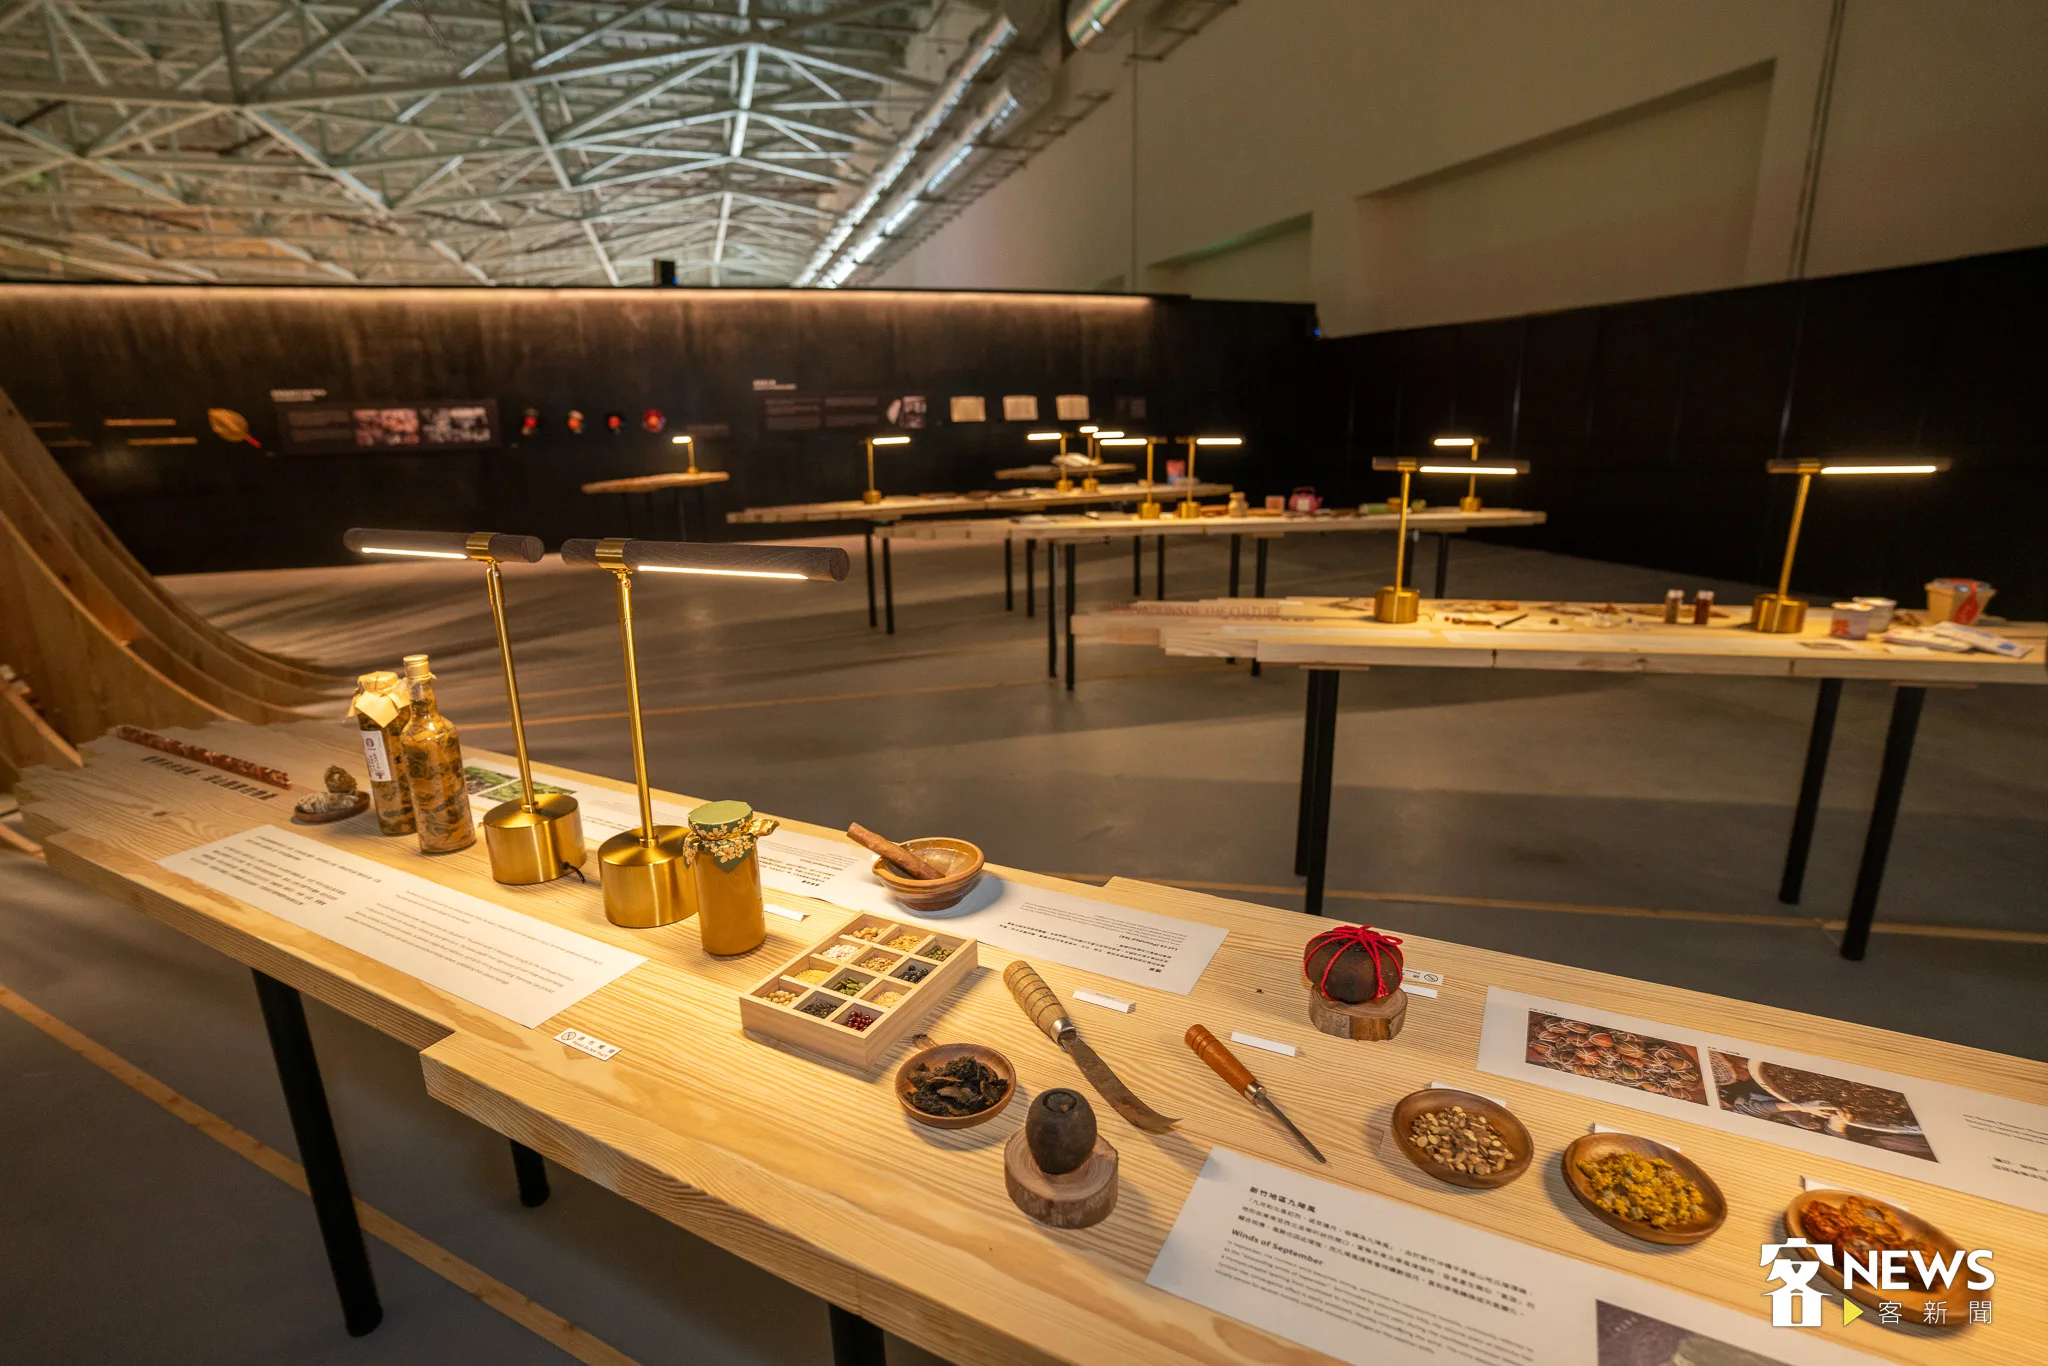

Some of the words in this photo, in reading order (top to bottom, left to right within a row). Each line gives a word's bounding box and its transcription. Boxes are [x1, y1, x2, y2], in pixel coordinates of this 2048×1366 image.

[1231, 1228, 1259, 1245] Winds
[1260, 1239, 1271, 1247] of
[1272, 1243, 1325, 1267] September
